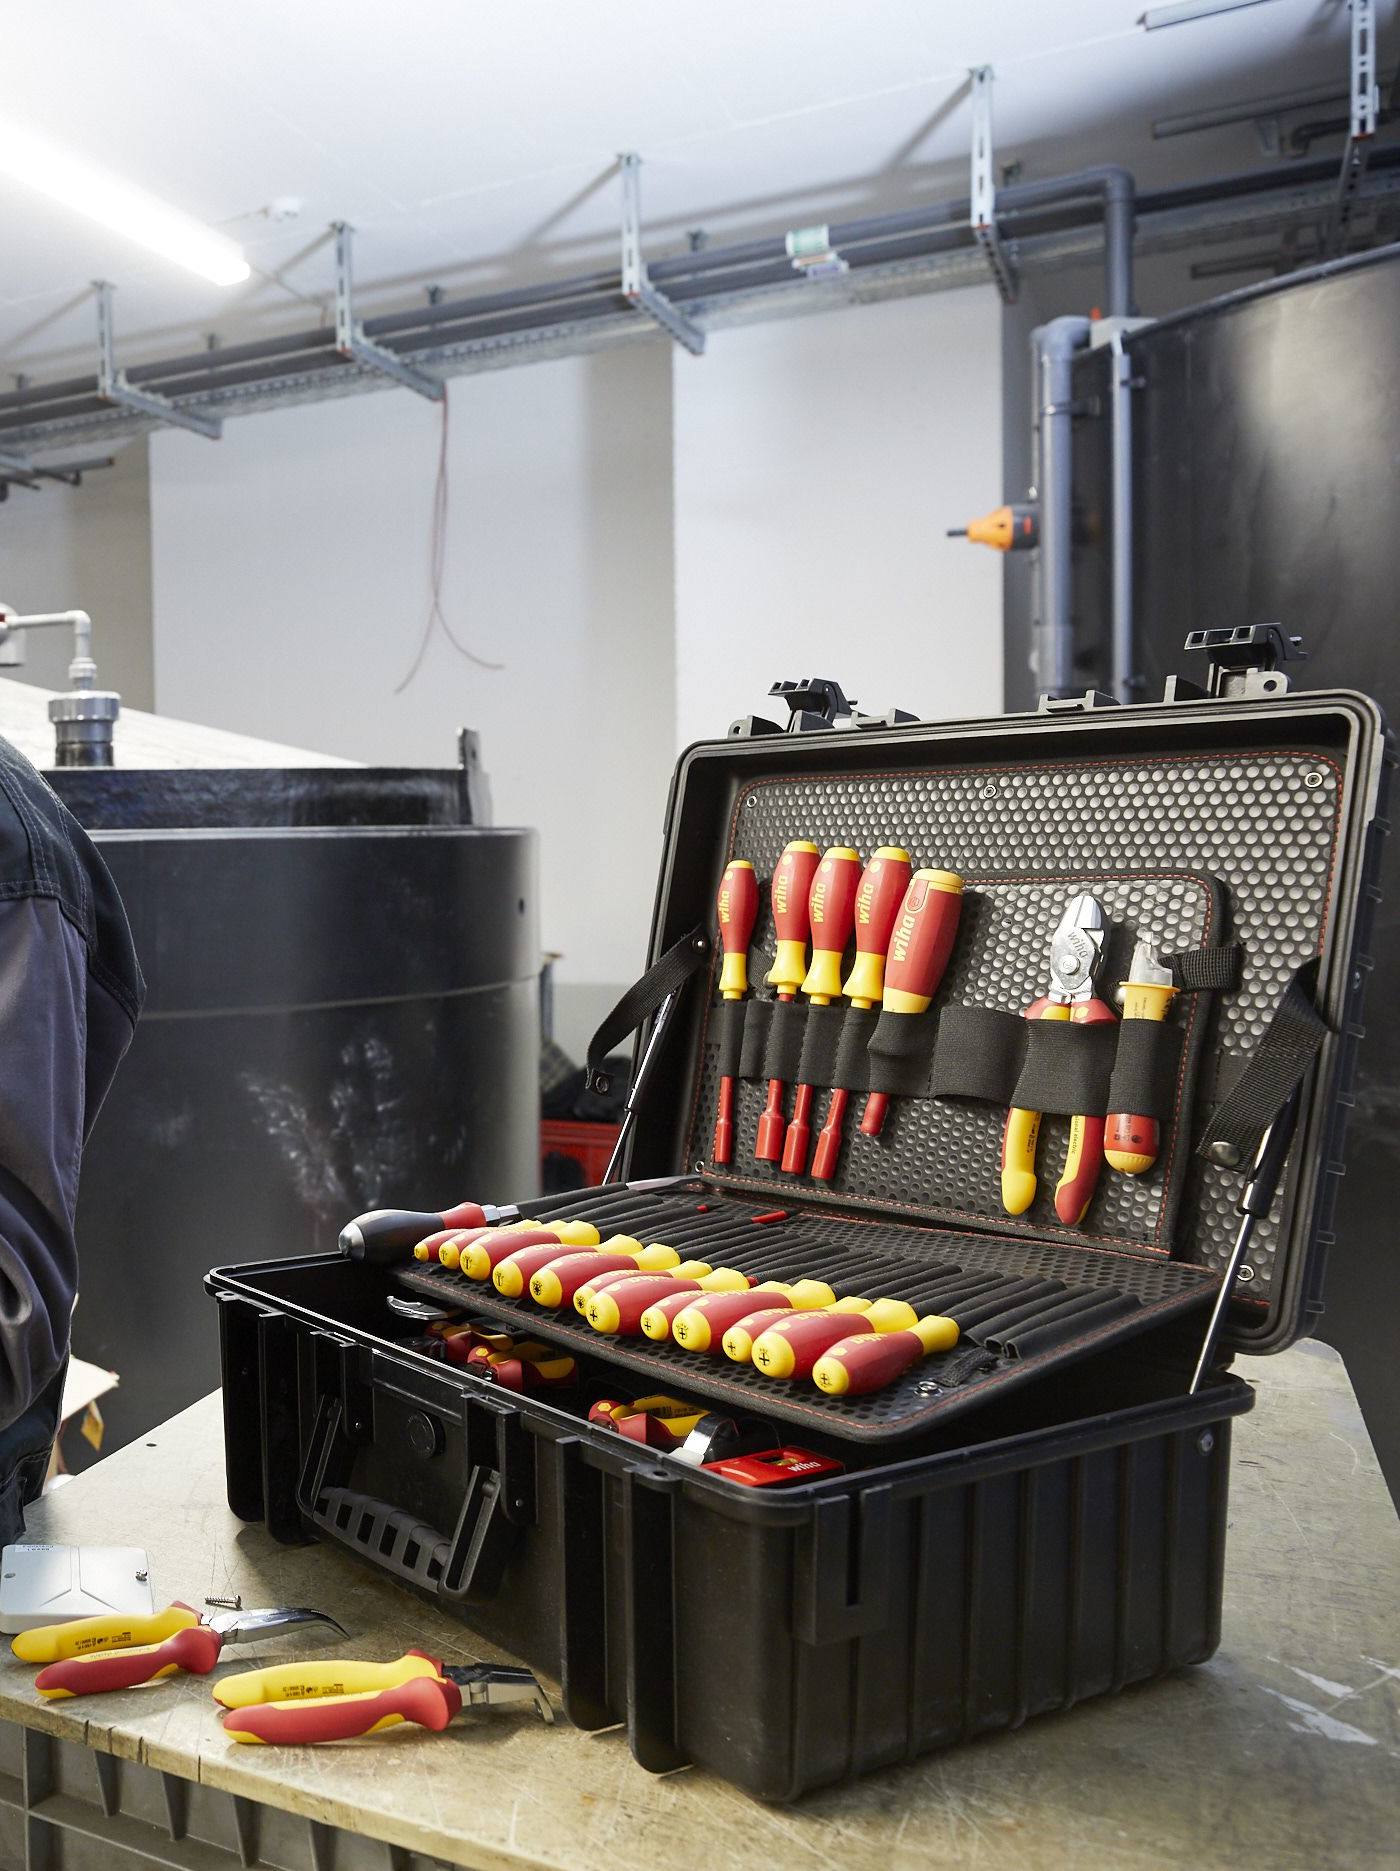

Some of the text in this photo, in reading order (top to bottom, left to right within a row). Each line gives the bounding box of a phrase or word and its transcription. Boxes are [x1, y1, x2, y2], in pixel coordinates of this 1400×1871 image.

[718, 890, 731, 924] wiha
[774, 874, 788, 914] wiha
[811, 882, 826, 923] wiha
[856, 882, 875, 925] wiha
[892, 914, 916, 962] wiha
[1067, 932, 1088, 959] wiha
[787, 1461, 821, 1472] wiha
